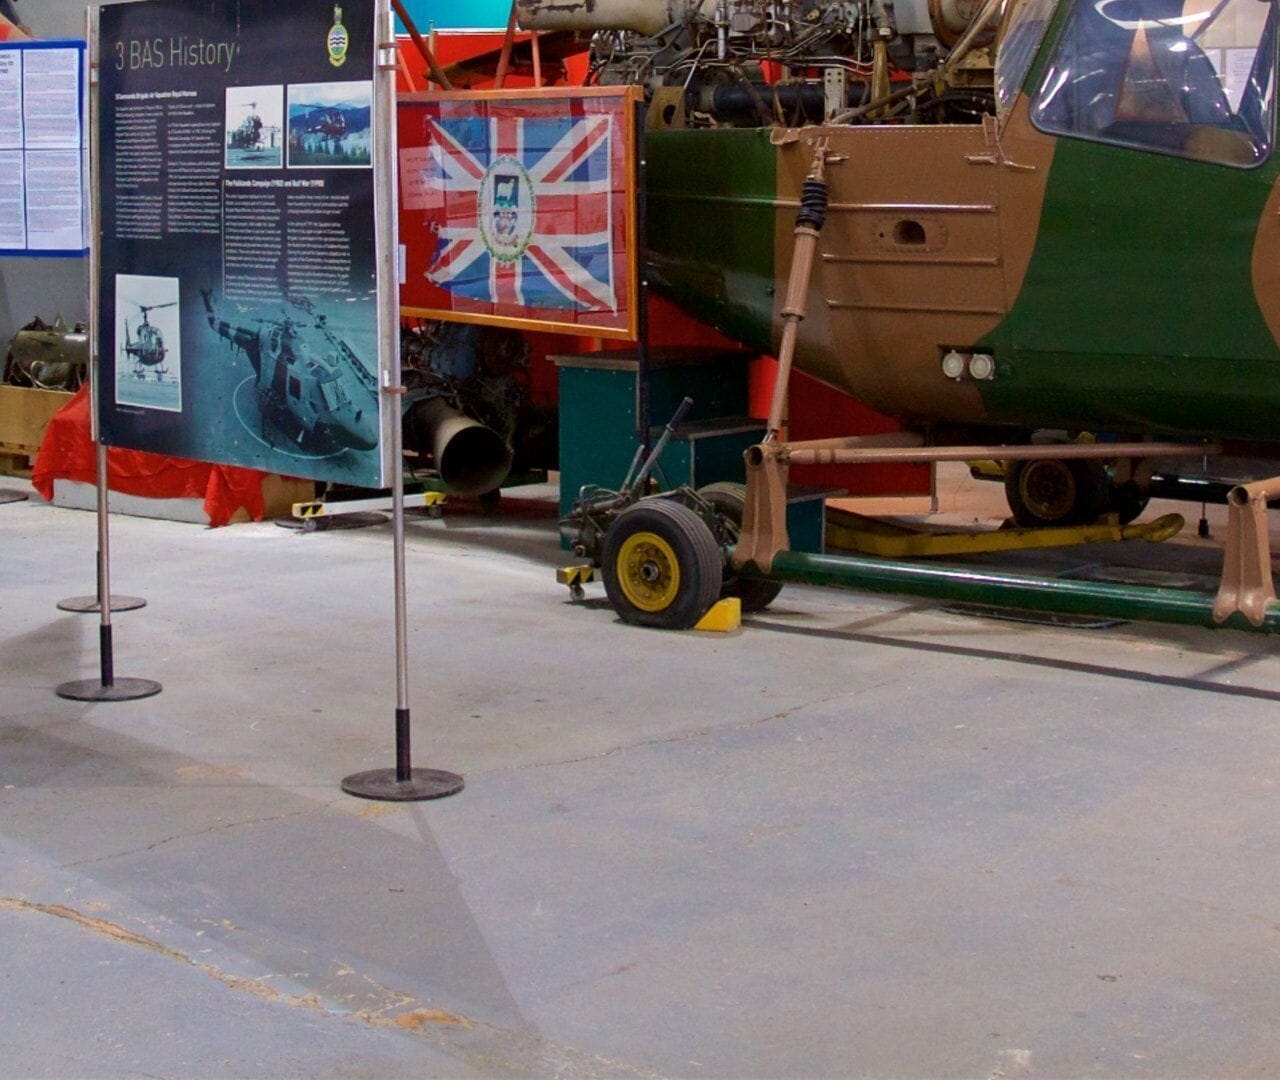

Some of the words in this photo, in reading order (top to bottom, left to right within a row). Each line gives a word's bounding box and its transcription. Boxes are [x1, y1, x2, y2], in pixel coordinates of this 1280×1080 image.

[115, 41, 124, 71] 3
[130, 37, 164, 70] BAS
[170, 35, 236, 73] History
